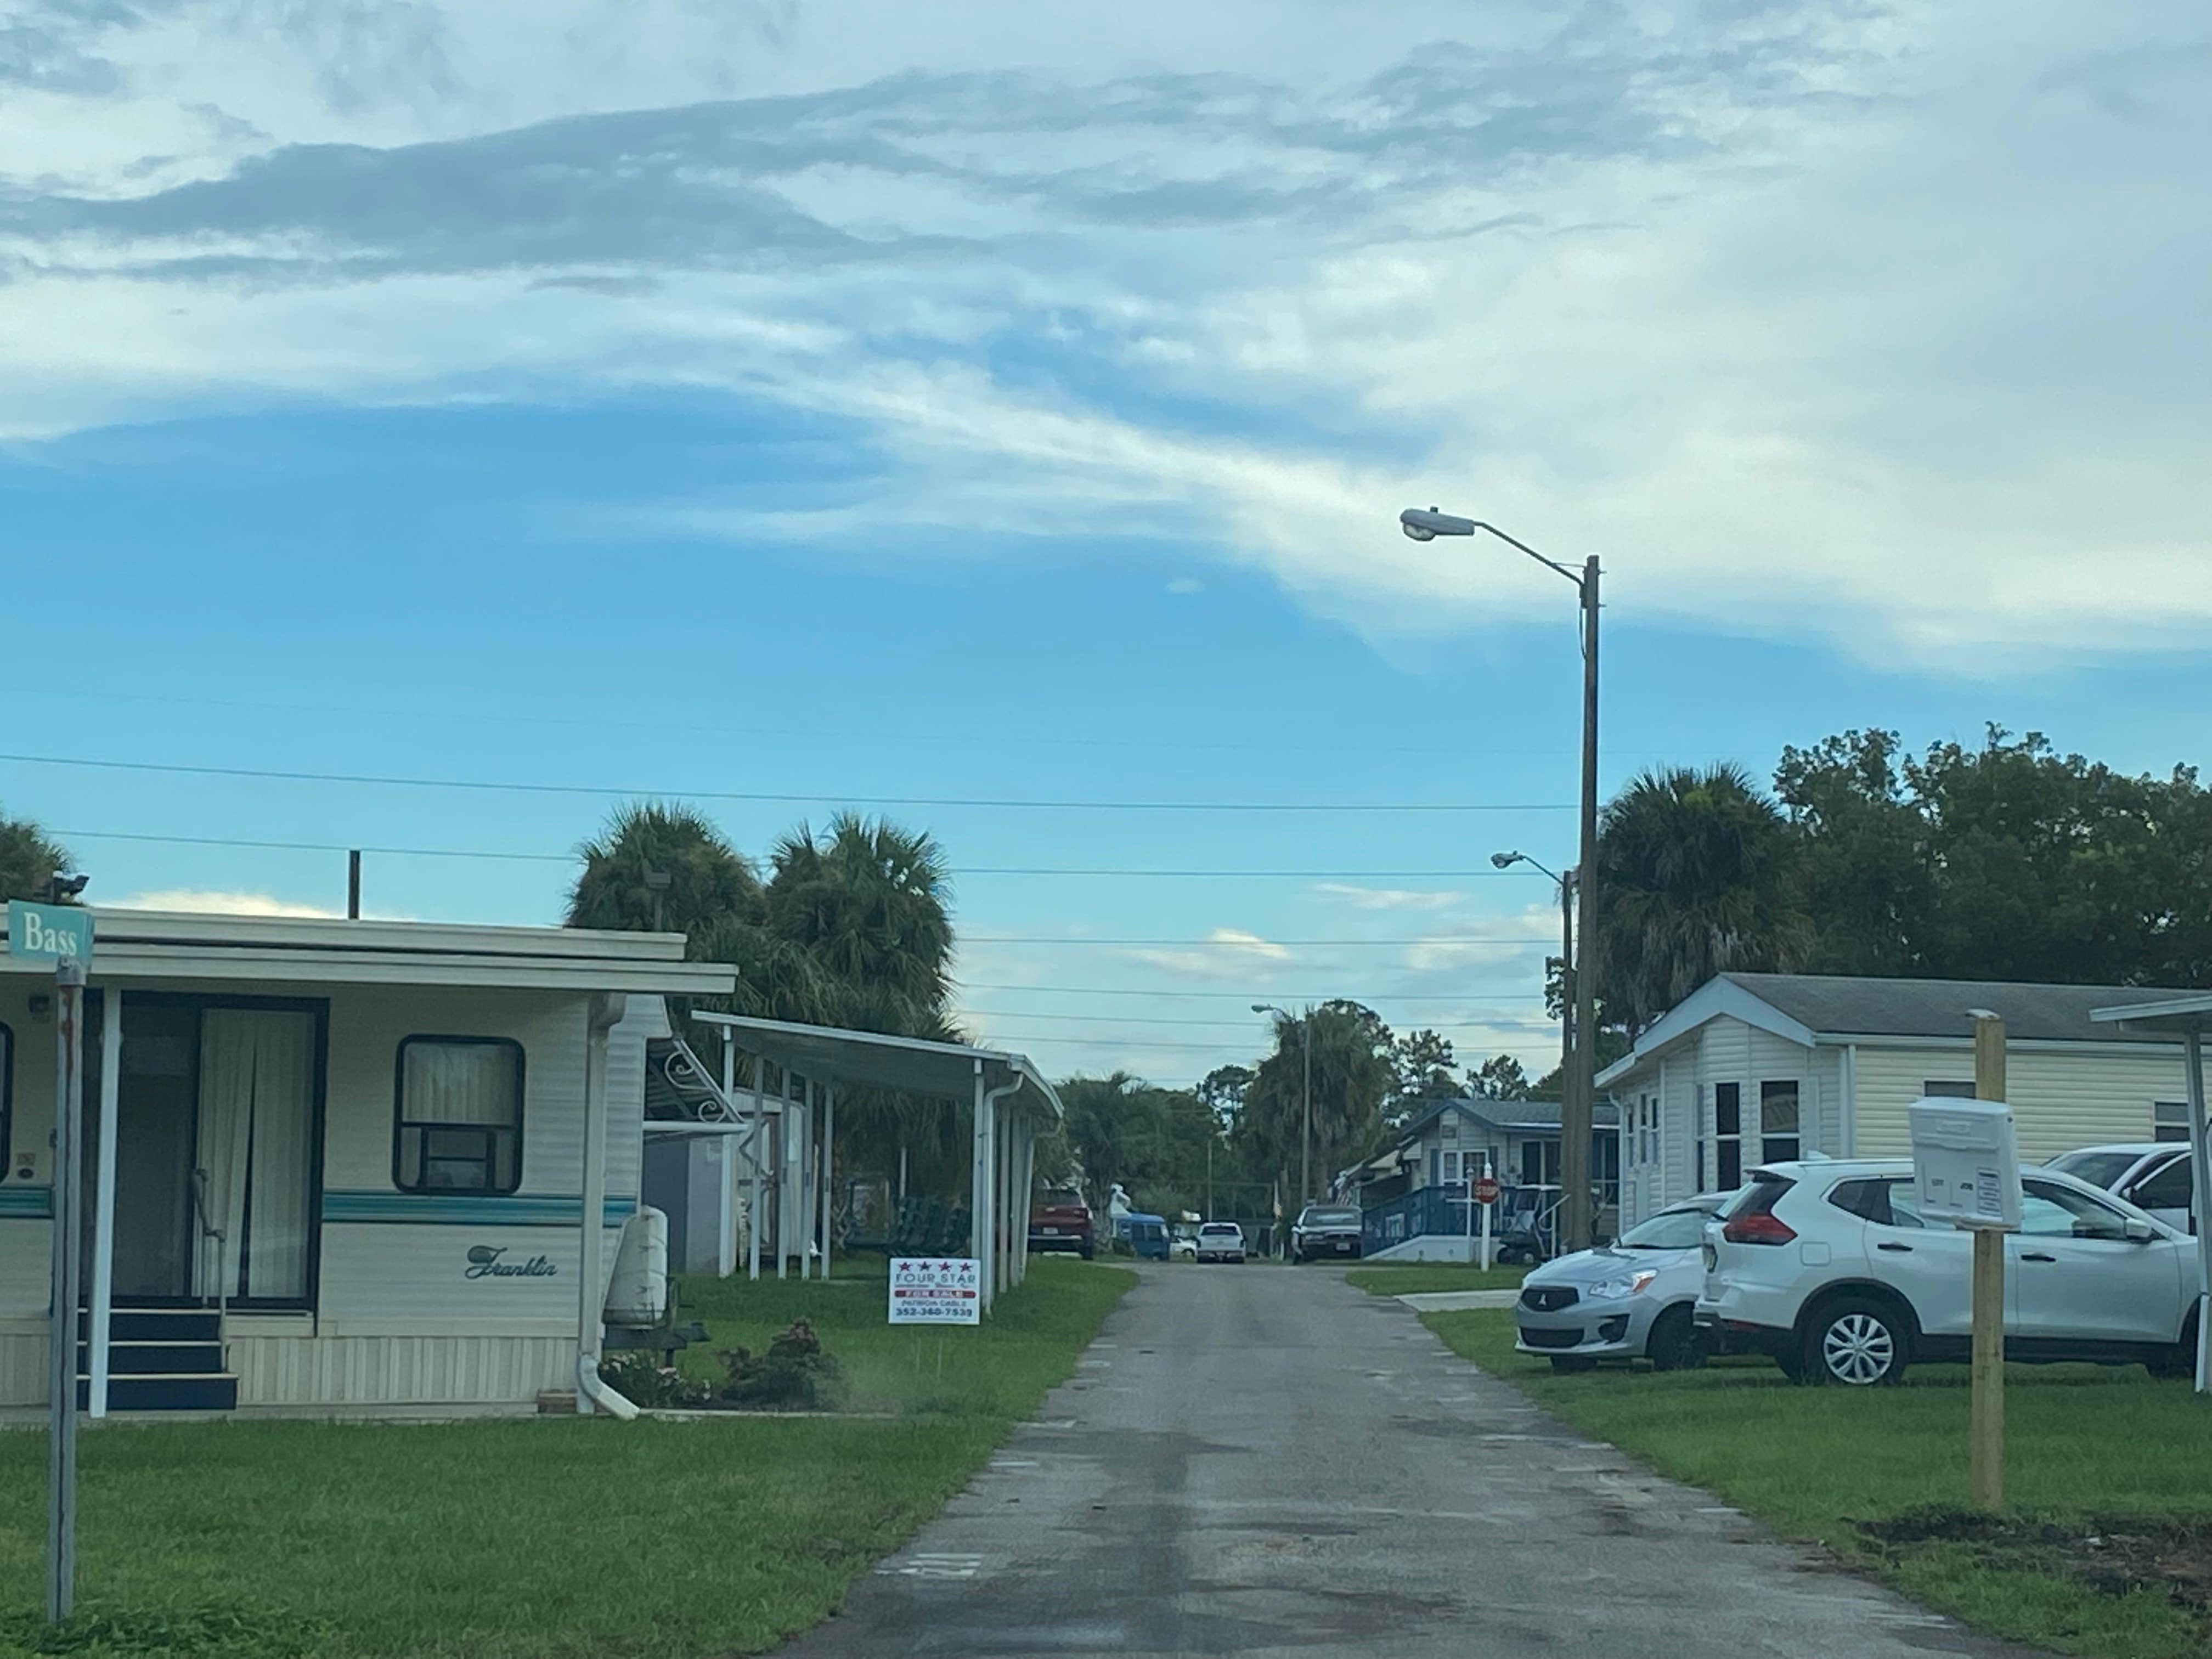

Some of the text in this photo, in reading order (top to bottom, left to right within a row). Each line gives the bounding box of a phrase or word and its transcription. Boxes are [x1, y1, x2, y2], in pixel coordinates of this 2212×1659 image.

[24, 912, 77, 956] Bass
[465, 1245, 558, 1279] Franklin
[896, 1273, 975, 1283] FOUR STAR
